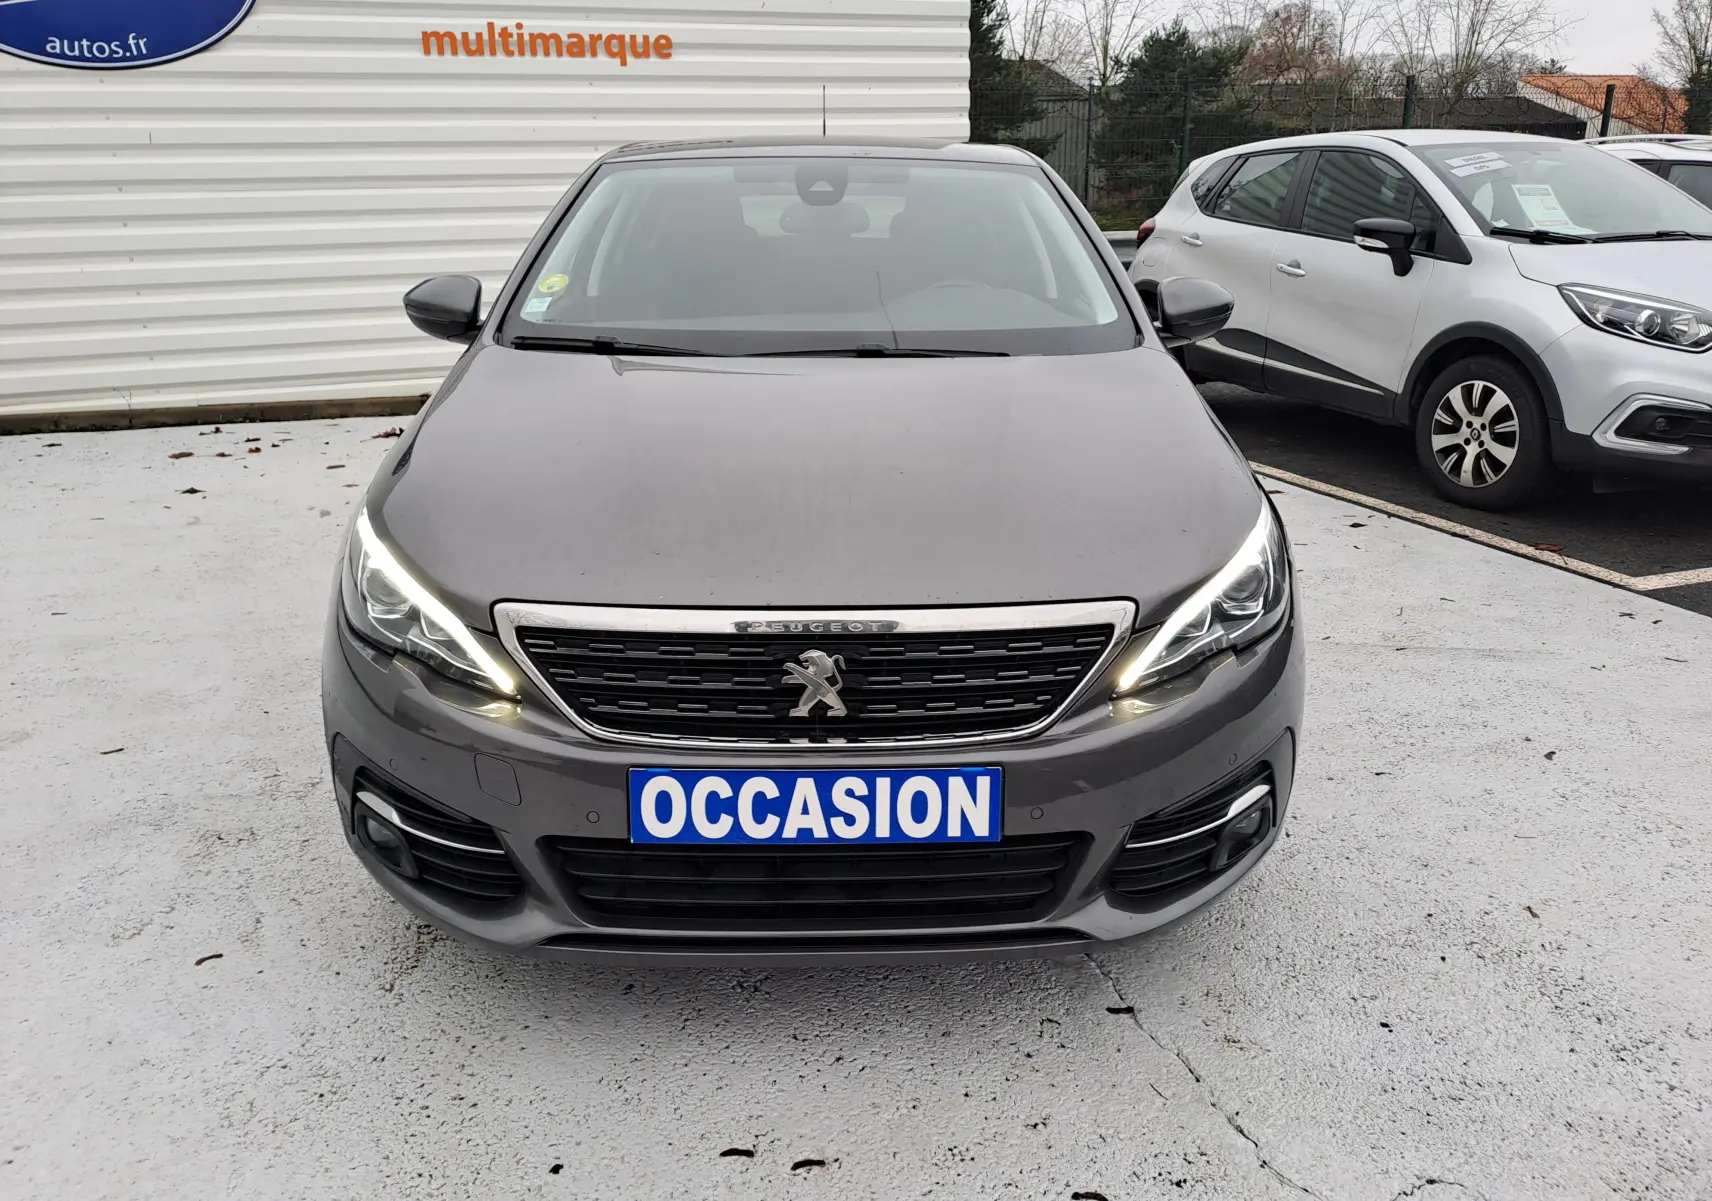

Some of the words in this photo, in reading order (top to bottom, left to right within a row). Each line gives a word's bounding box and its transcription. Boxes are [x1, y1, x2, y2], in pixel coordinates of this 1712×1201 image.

[45, 33, 147, 58] autos.fr
[421, 21, 673, 67] multimarque
[749, 620, 883, 632] PEUGEOT
[640, 775, 991, 839] OCCASION
